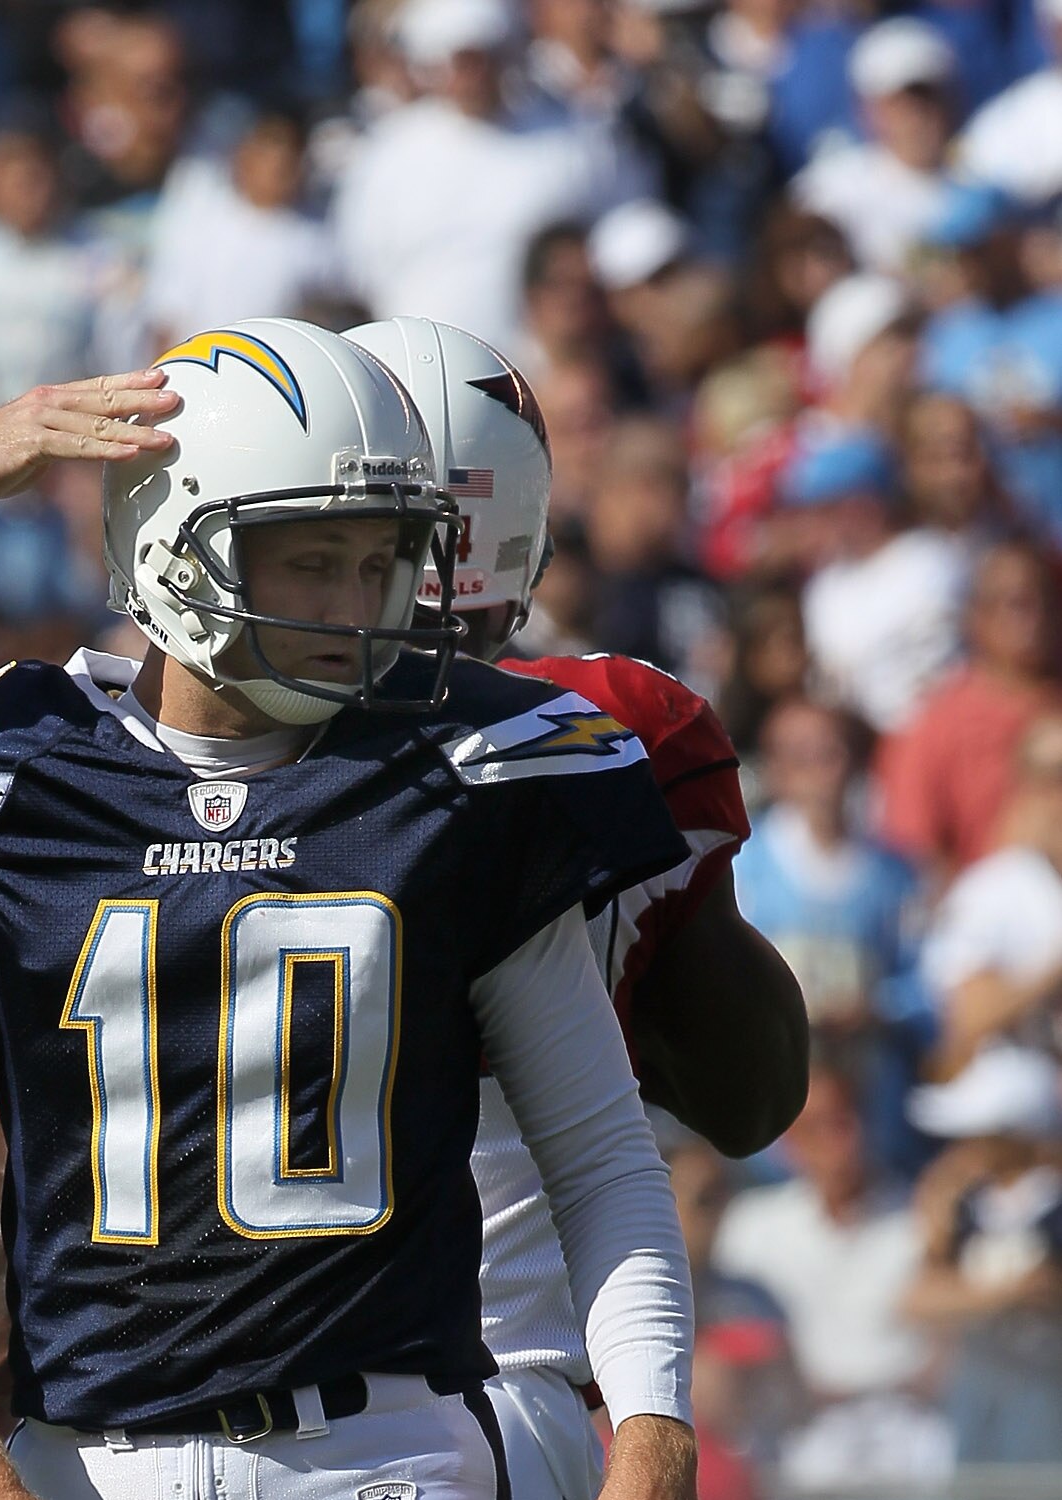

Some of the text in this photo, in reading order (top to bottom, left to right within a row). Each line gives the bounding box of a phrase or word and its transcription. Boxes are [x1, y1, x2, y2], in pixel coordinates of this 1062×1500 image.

[207, 807, 229, 821] NFL
[142, 837, 298, 876] CHARGERS
[59, 891, 403, 1246] 10
